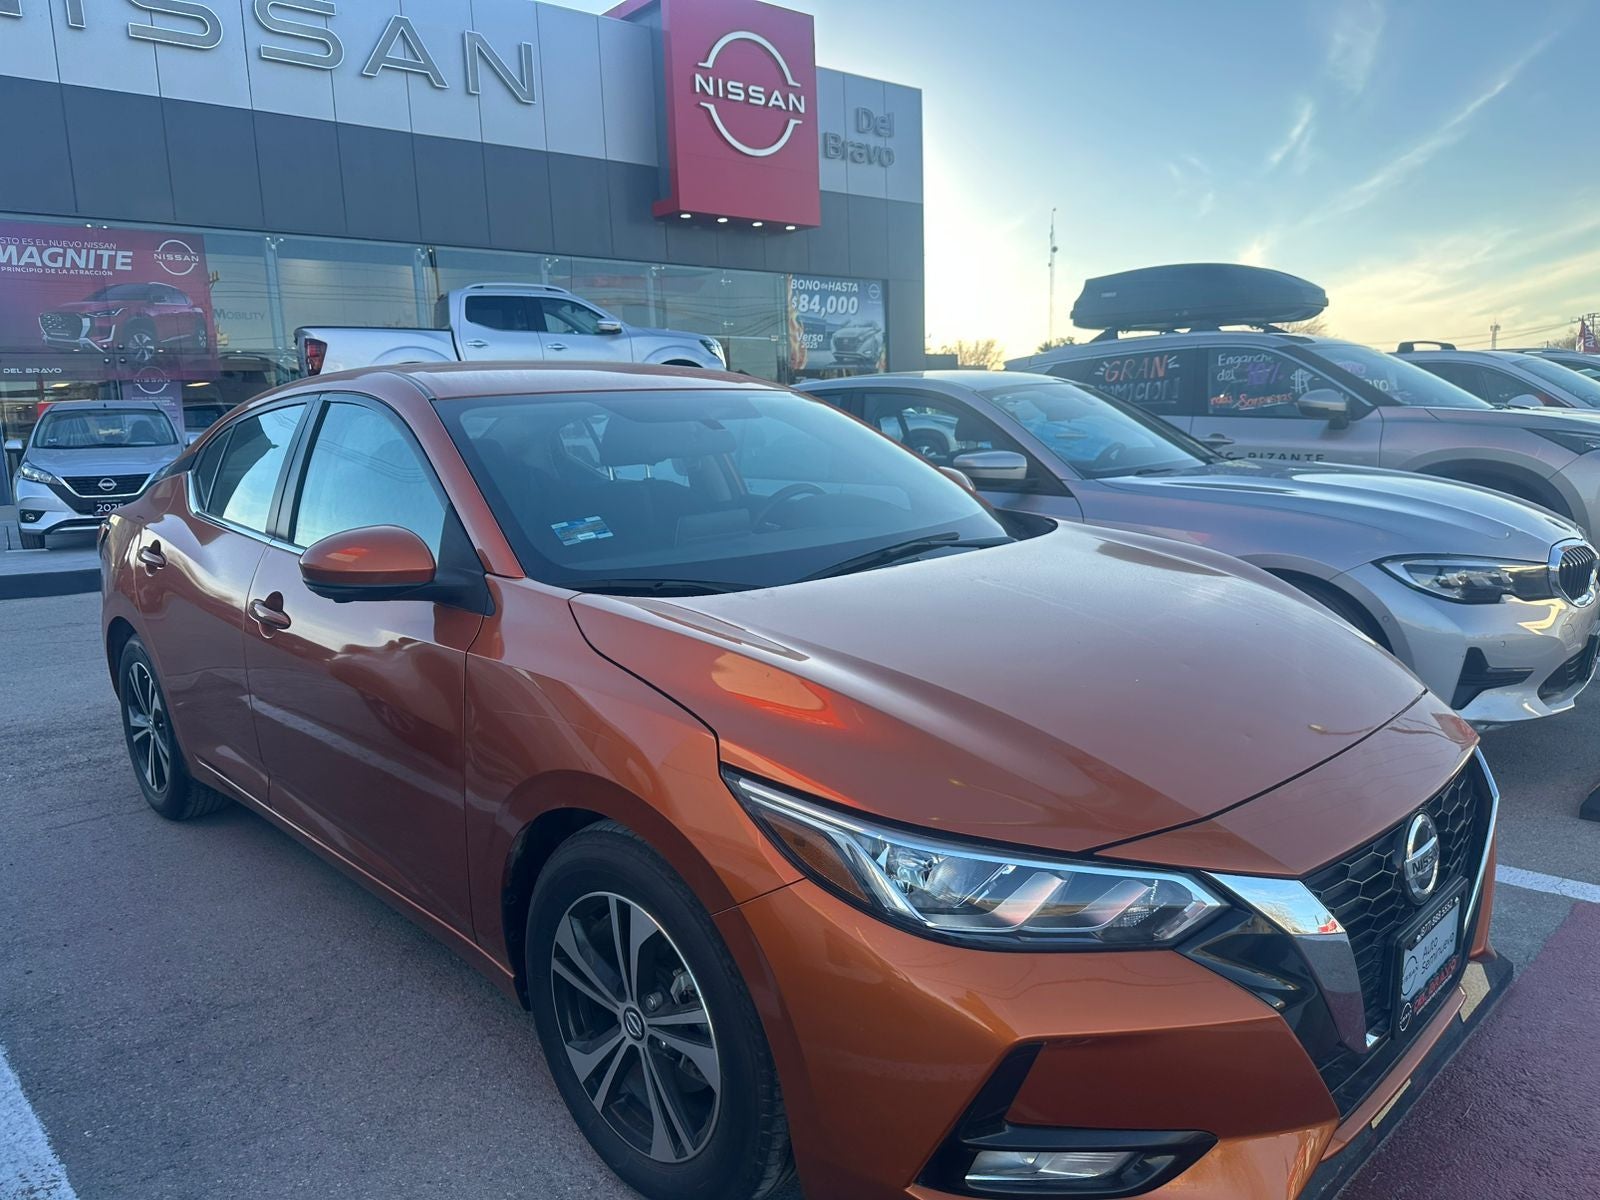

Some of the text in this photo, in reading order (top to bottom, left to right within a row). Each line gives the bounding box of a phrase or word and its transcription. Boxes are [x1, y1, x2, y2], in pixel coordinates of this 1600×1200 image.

[0, 0, 536, 103] SSAN
[695, 73, 805, 113] NISSAN
[856, 107, 894, 138] Del
[823, 132, 895, 168] Bravo
[22, 238, 33, 246] ES
[36, 239, 47, 247] EL
[49, 239, 81, 248] NUEVO
[84, 241, 116, 250] NISSAN
[0, 245, 133, 270] MAGNITE
[153, 253, 199, 262] NISSAN
[1, 266, 43, 274] PRINCIPIO
[790, 279, 820, 291] BONO
[828, 282, 859, 293] HASTA
[791, 294, 859, 317] $84,000
[796, 331, 824, 342] Versa
[1105, 354, 1168, 383] GRAN
[1217, 368, 1236, 382] del
[1422, 936, 1439, 959] Auto
